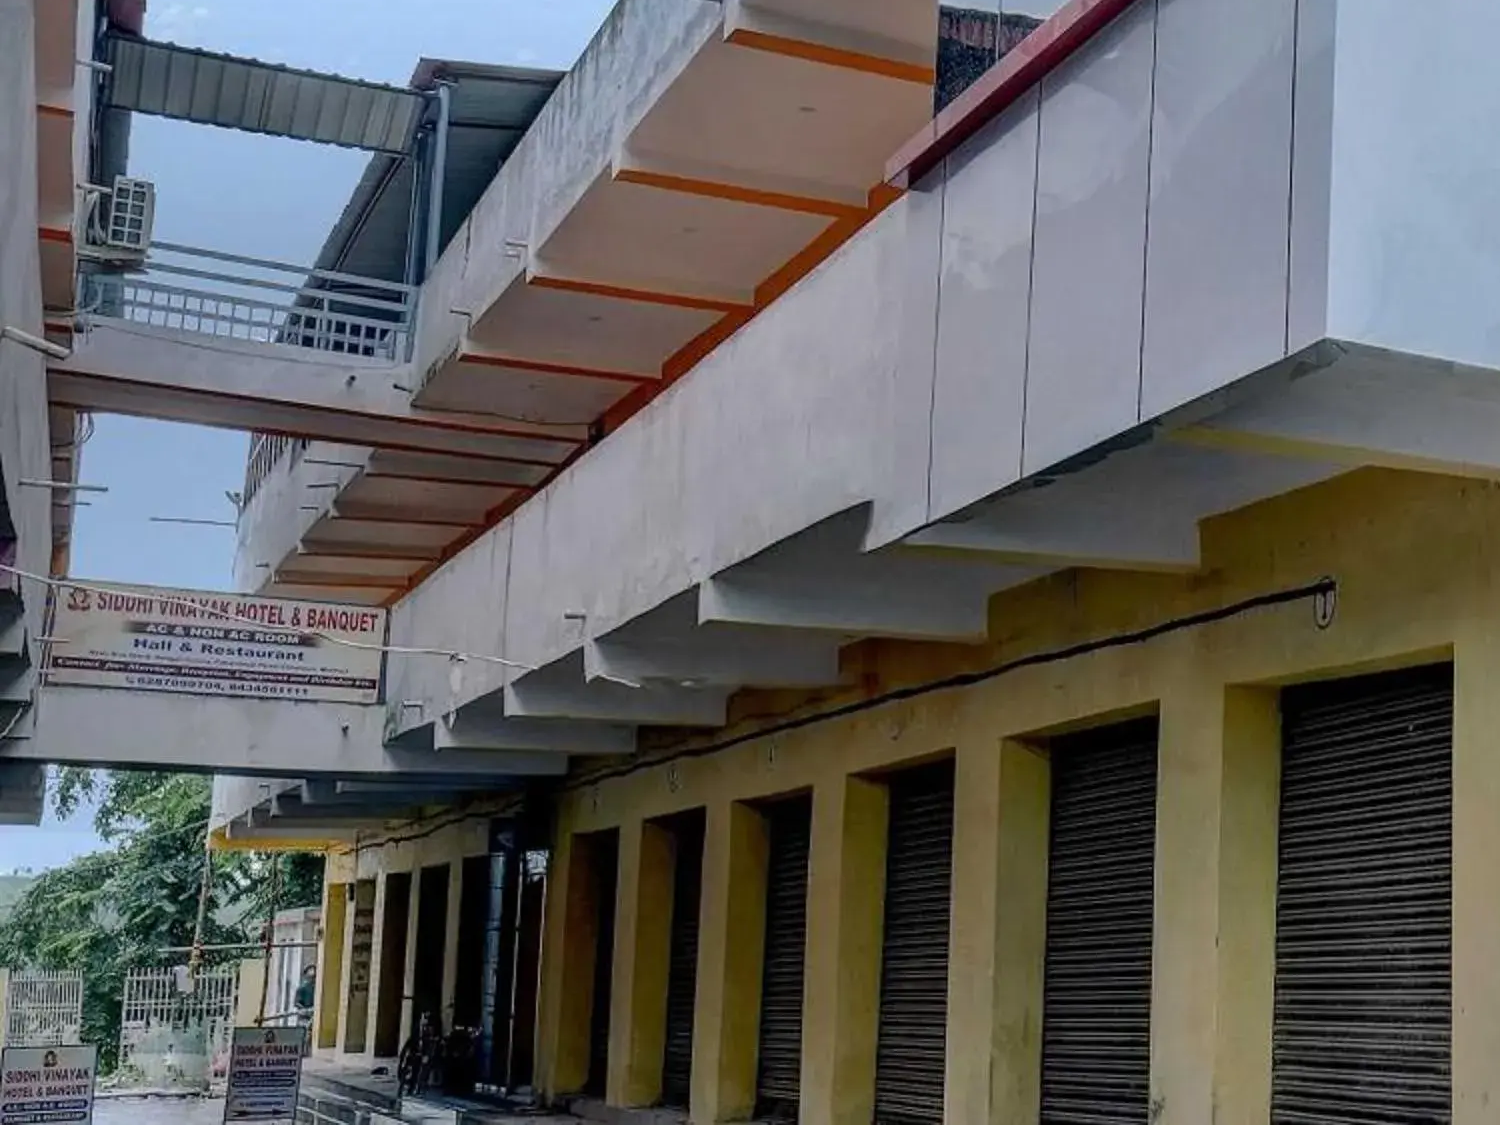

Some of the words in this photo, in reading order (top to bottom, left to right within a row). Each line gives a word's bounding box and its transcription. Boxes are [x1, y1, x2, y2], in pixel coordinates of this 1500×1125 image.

[97, 590, 153, 614] SIDDHI
[235, 602, 286, 625] HOTEL
[291, 607, 301, 626] &
[307, 608, 379, 633] BANQUET
[190, 627, 224, 638] NON
[230, 630, 251, 641] AC
[255, 632, 300, 645] ROOM
[133, 638, 172, 652] Hall
[179, 641, 193, 653] &
[201, 642, 304, 662] Restaurant
